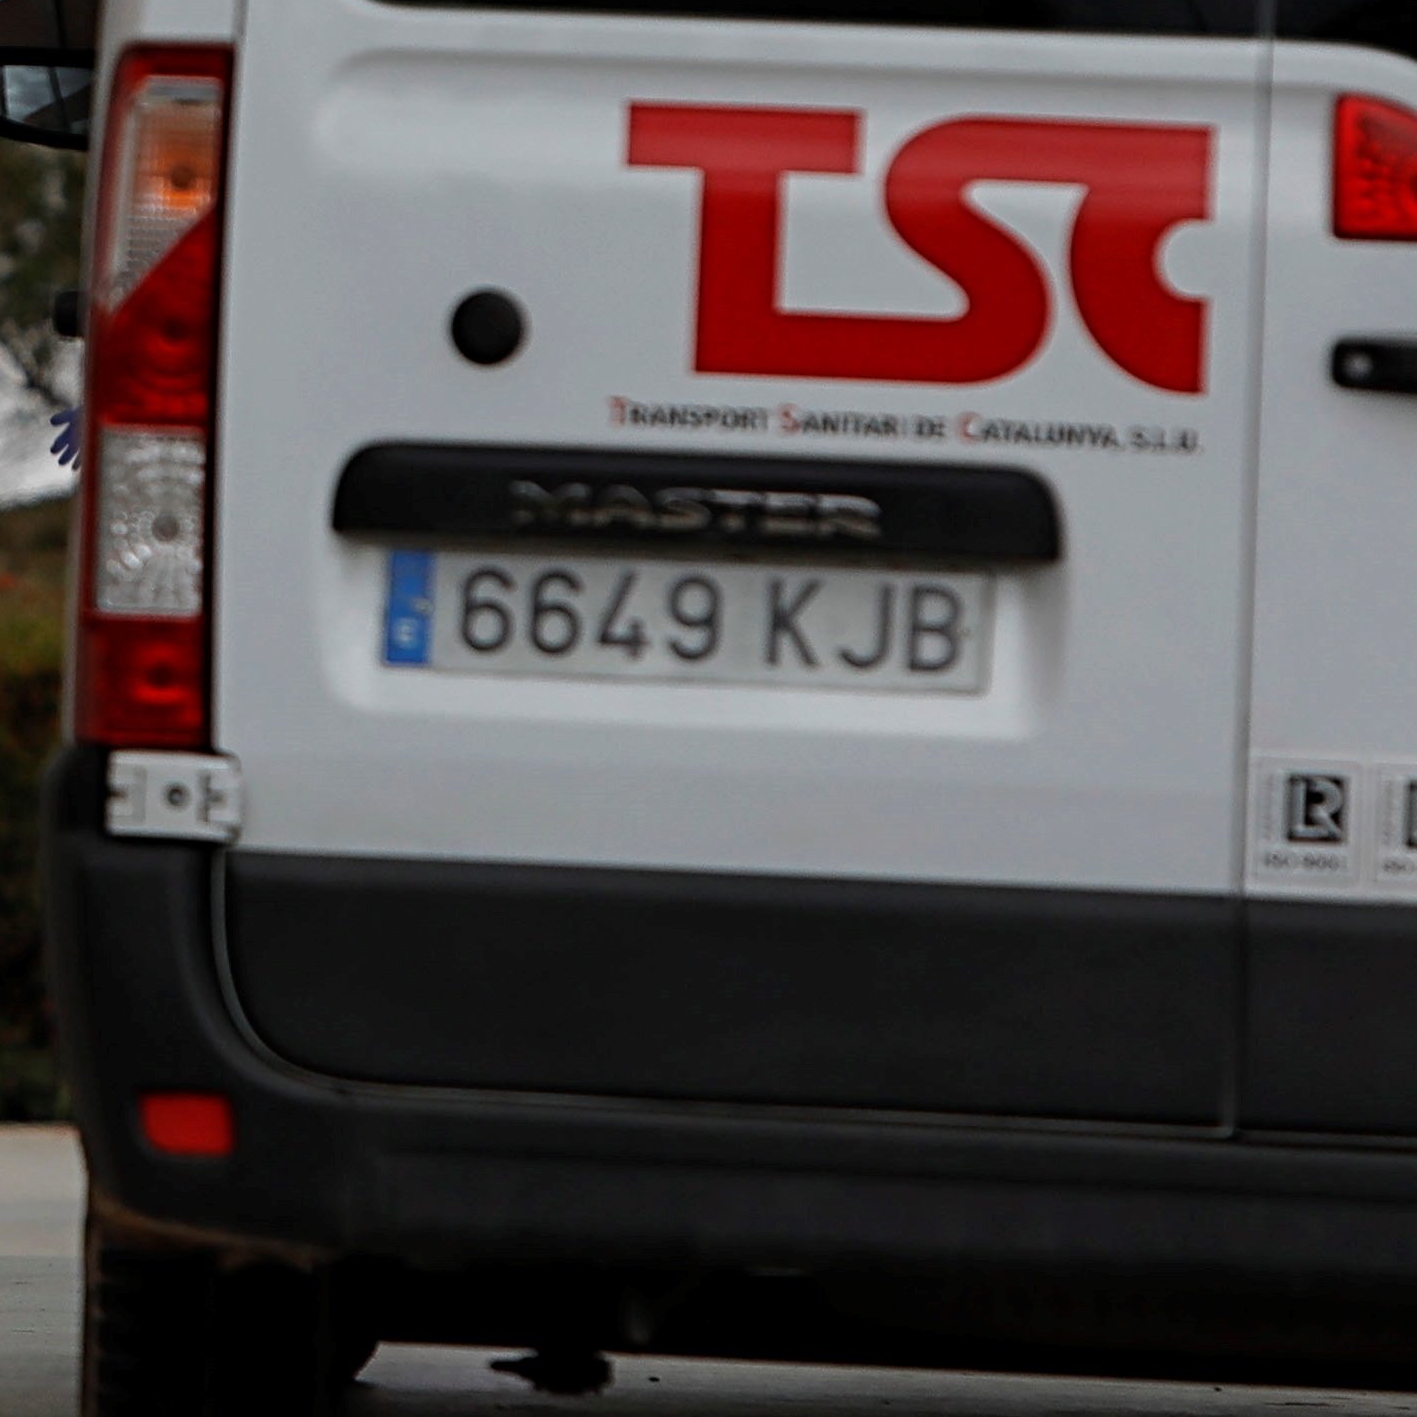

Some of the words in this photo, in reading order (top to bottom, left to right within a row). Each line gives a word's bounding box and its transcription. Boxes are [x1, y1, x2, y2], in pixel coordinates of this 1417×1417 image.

[608, 396, 768, 430] TRANSPORT
[915, 415, 945, 438] DE
[509, 480, 883, 539] MASTER
[459, 566, 723, 662] 6649
[765, 578, 963, 673] KJB
